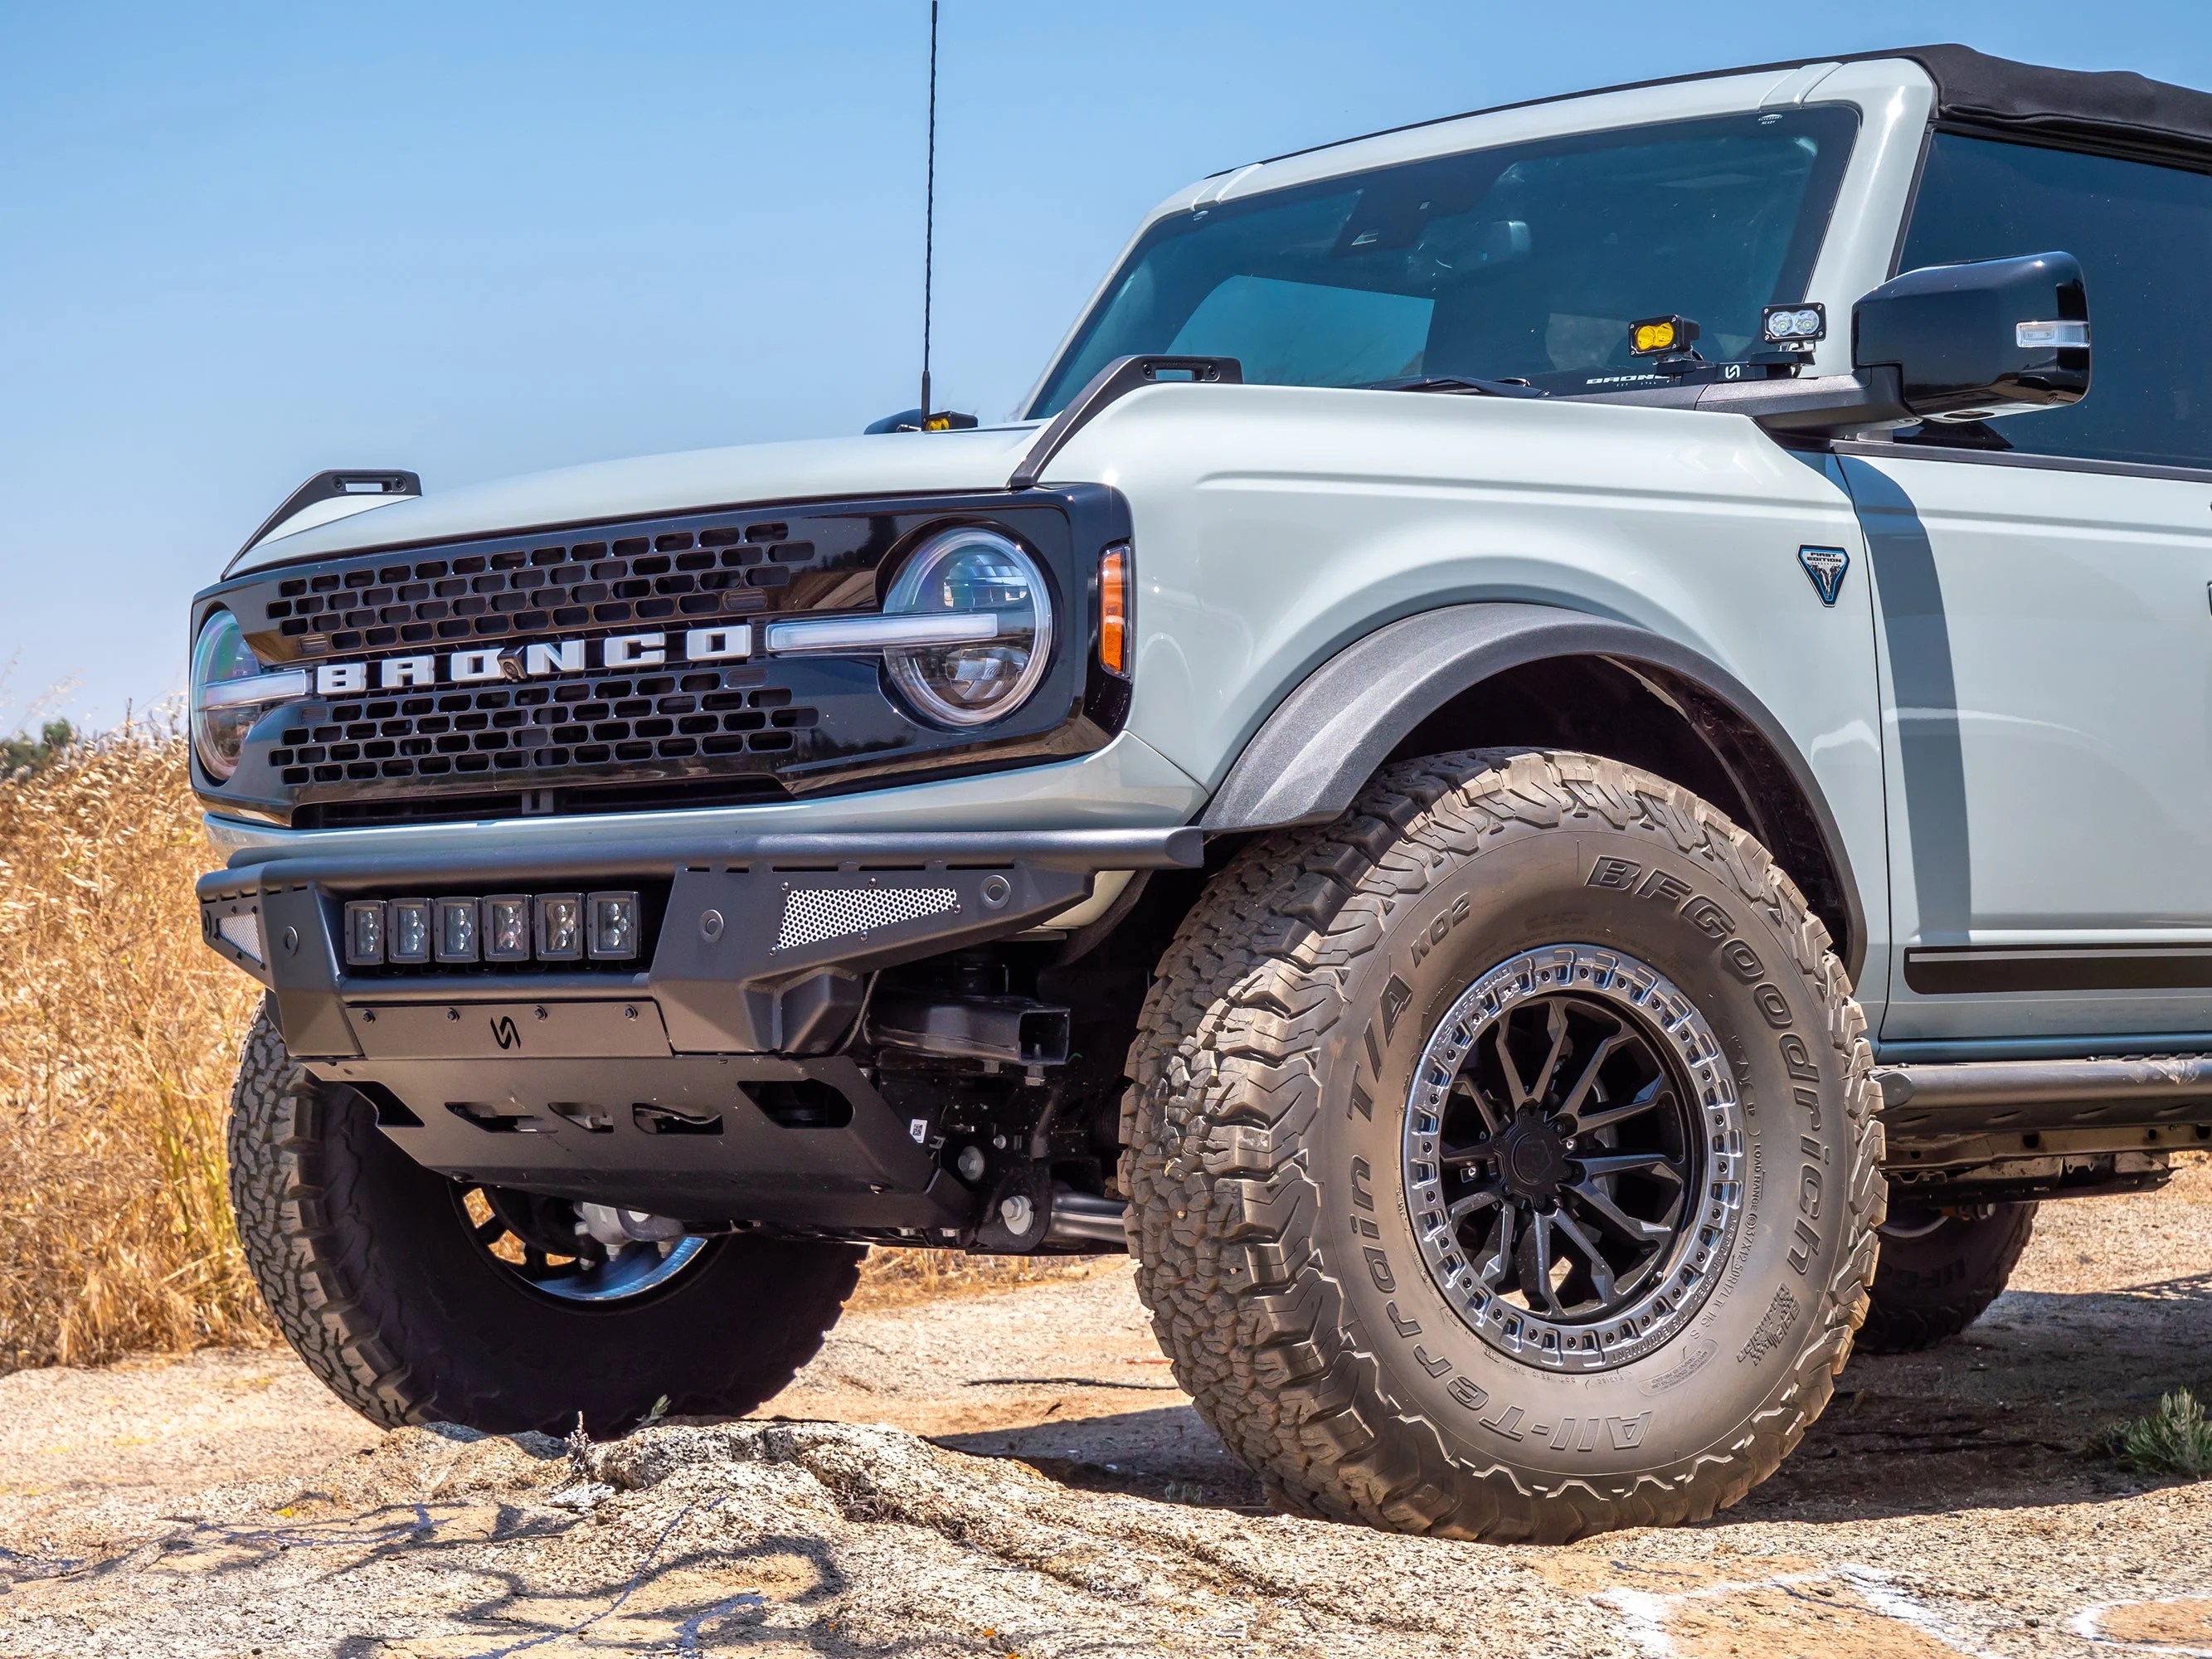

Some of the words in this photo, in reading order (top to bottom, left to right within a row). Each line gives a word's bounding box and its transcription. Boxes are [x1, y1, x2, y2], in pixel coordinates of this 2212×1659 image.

[1586, 374, 1682, 385] BRON
[317, 624, 752, 697] BRONCO
[1347, 972, 1413, 1122] T/A
[1411, 892, 1471, 968] KO2
[1453, 967, 1510, 1022] OFFROAD
[1585, 855, 1830, 1276] BFGoodrich
[1753, 1143, 1762, 1172] LOAD
[1750, 1175, 1761, 1212] RANGE
[1714, 1214, 1738, 1272] OFFROAD
[1349, 1154, 1653, 1452] All-Terrain
[1612, 1326, 1671, 1364] EQUIPMENT
